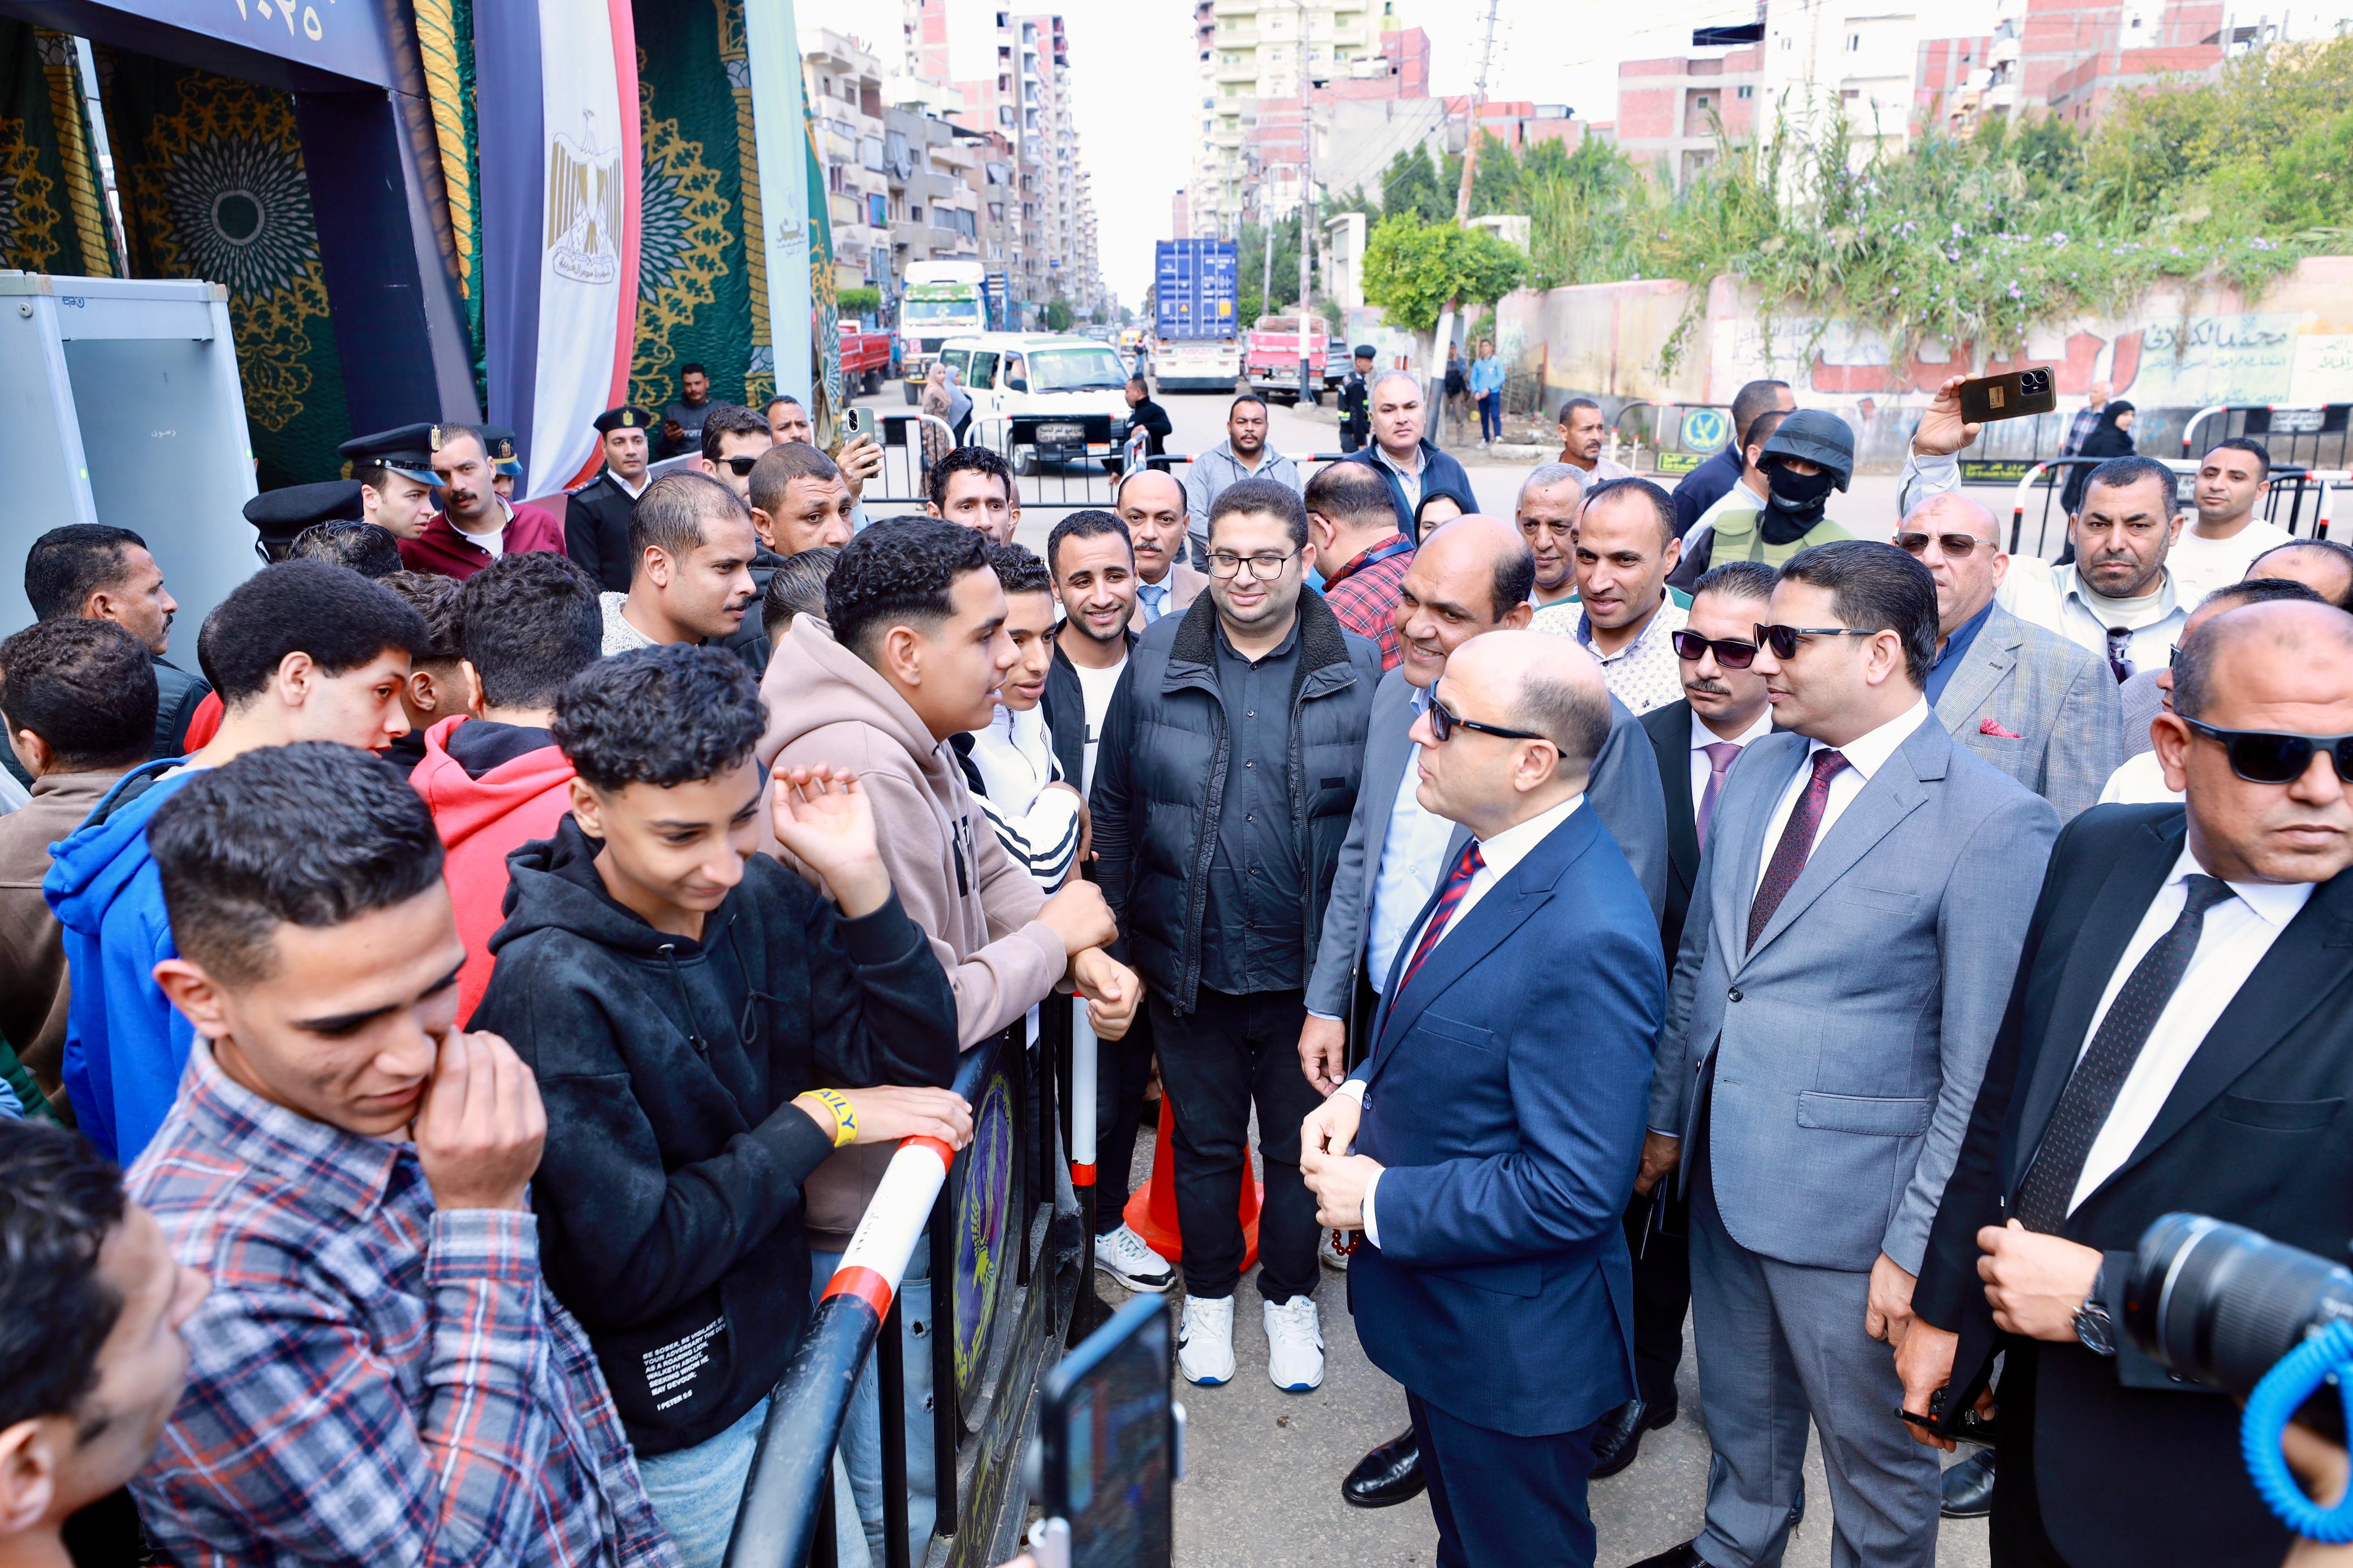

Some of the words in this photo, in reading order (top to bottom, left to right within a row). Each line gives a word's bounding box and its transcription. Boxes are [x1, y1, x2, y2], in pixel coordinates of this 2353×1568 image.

[819, 1091, 855, 1129] AILY
[643, 1351, 654, 1360] BE
[681, 1336, 690, 1345] BE
[644, 1354, 665, 1366] YOUR
[665, 1336, 703, 1359] ADVERSARY
[704, 1329, 715, 1340] THE
[715, 1322, 726, 1333] DEV
[645, 1364, 656, 1373] AS
[663, 1349, 693, 1367] ROARING
[646, 1362, 680, 1380] WALKETH
[649, 1371, 680, 1388] SEEKING
[680, 1360, 700, 1376] WHOM
[700, 1355, 709, 1365] HE
[651, 1384, 666, 1396] MAY
[661, 1394, 683, 1410] PETER
